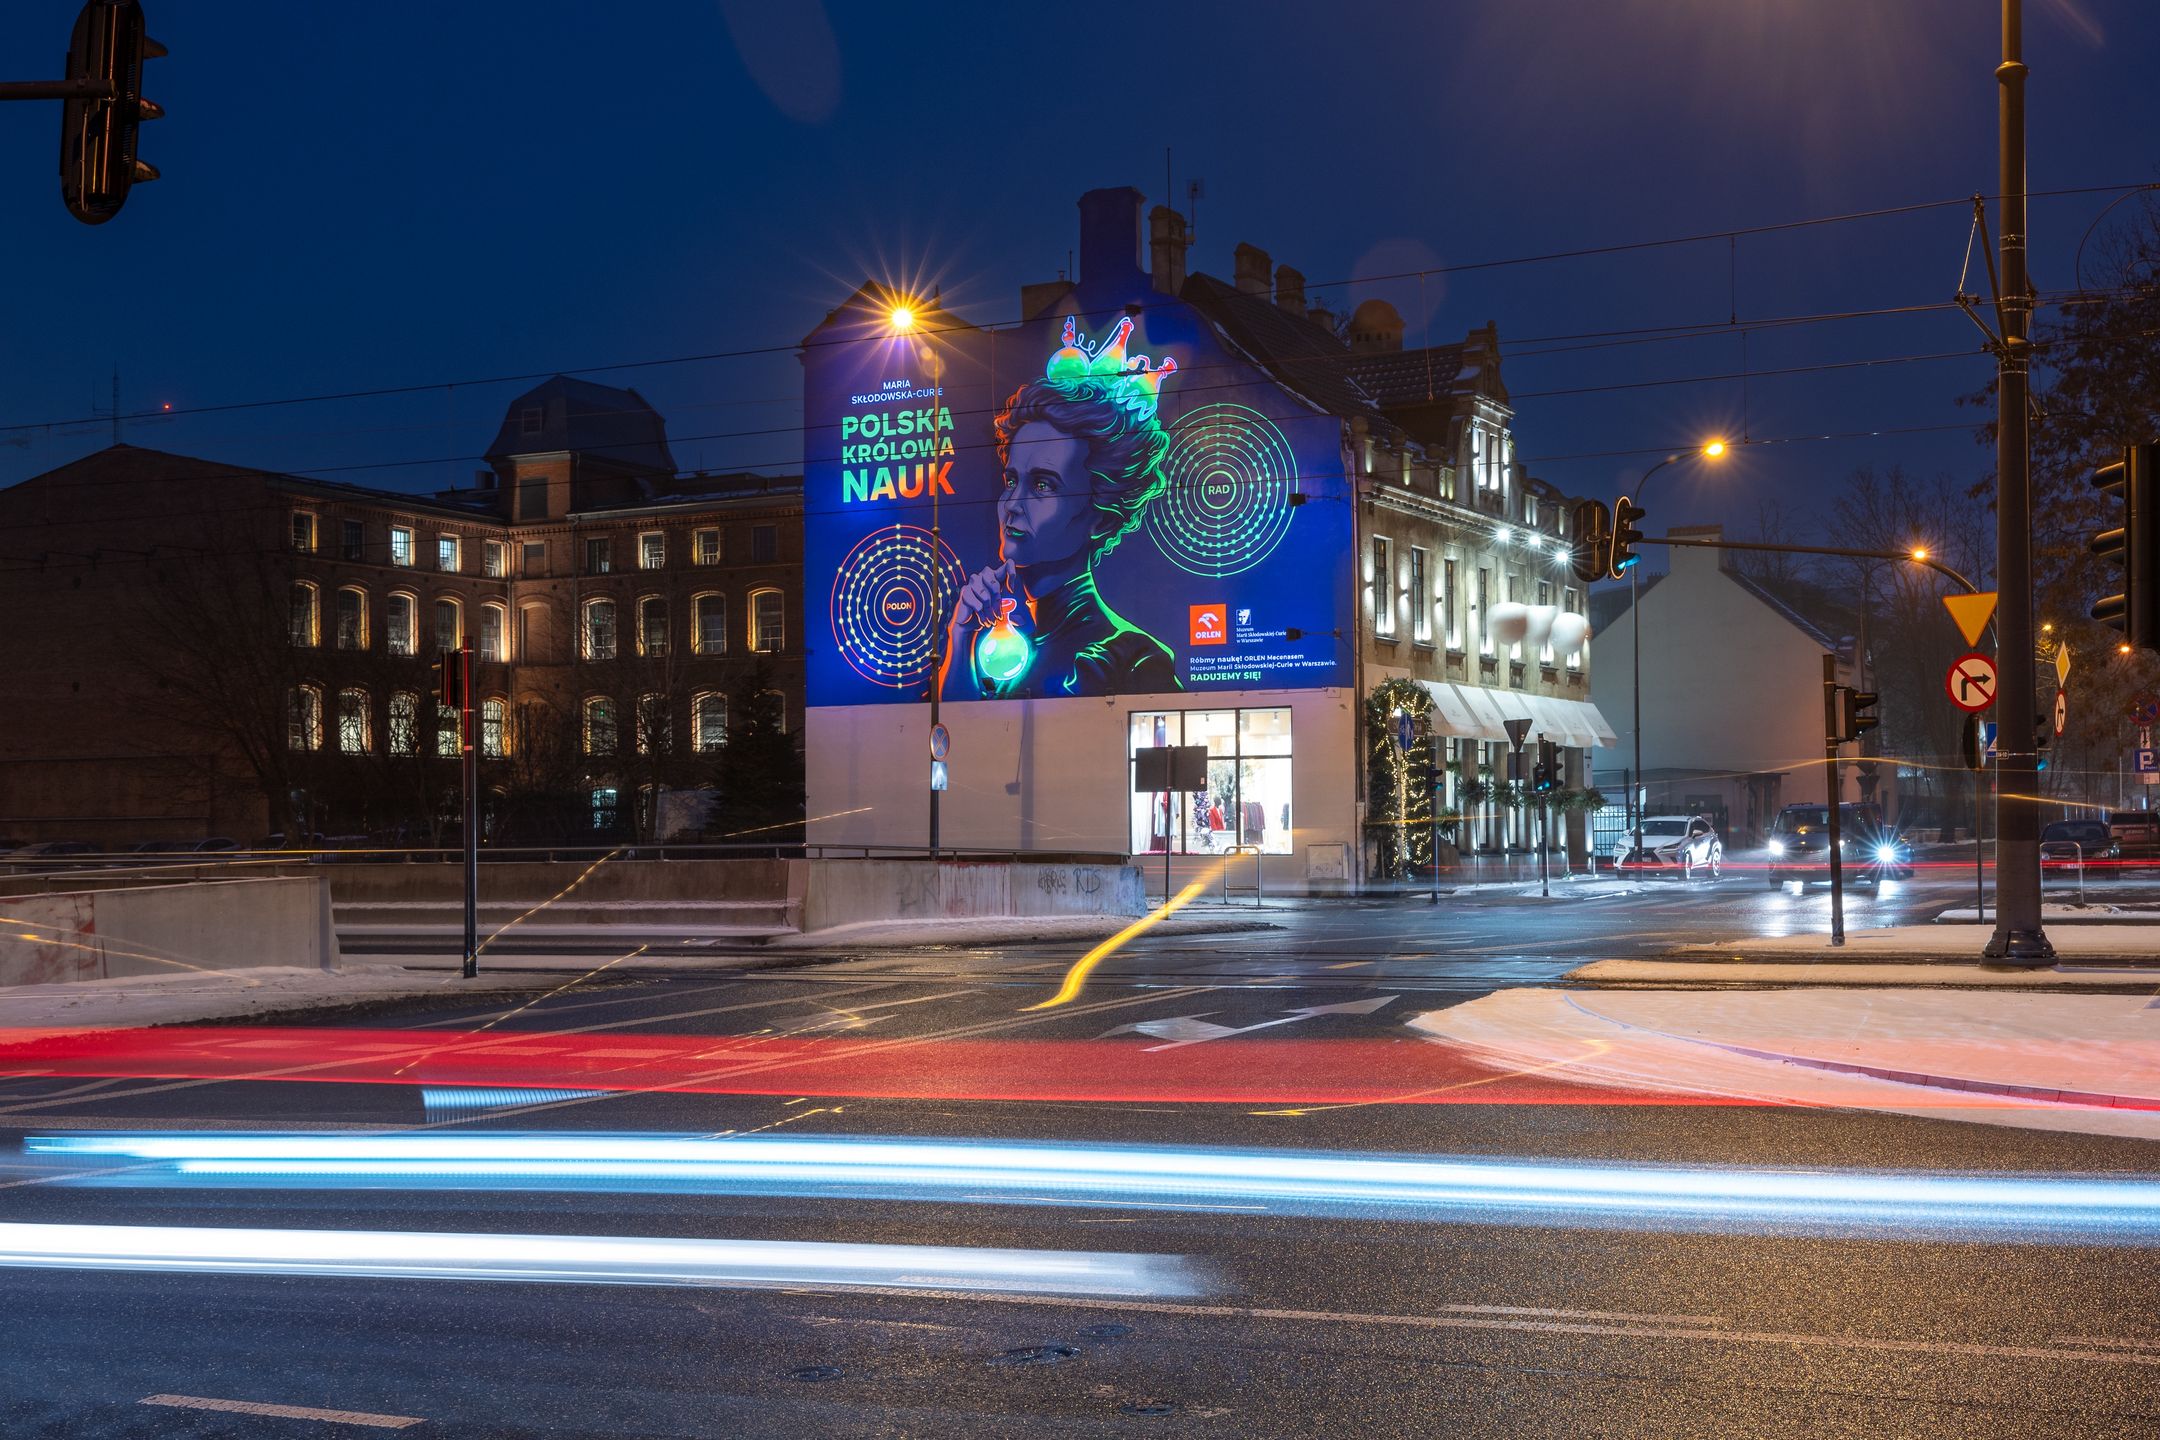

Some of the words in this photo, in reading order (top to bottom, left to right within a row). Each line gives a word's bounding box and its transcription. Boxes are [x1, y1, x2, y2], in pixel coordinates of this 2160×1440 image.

[883, 379, 911, 390] MARIA
[851, 388, 943, 405] SKŁODOWSKA-CURE
[842, 407, 954, 441] POLSKA
[842, 436, 955, 465] KRÓLOWA
[842, 461, 956, 503] NAUK
[1208, 484, 1230, 495] RAD
[886, 602, 912, 610] POLON
[1195, 630, 1221, 639] ORLEN
[1217, 655, 1243, 663] naukę!
[1234, 661, 1293, 669] Skłodowskiej-Curie
[1190, 672, 1241, 681] RADUJEMY
[1243, 671, 1261, 681] SIĘ!
[2139, 752, 2154, 770] P
